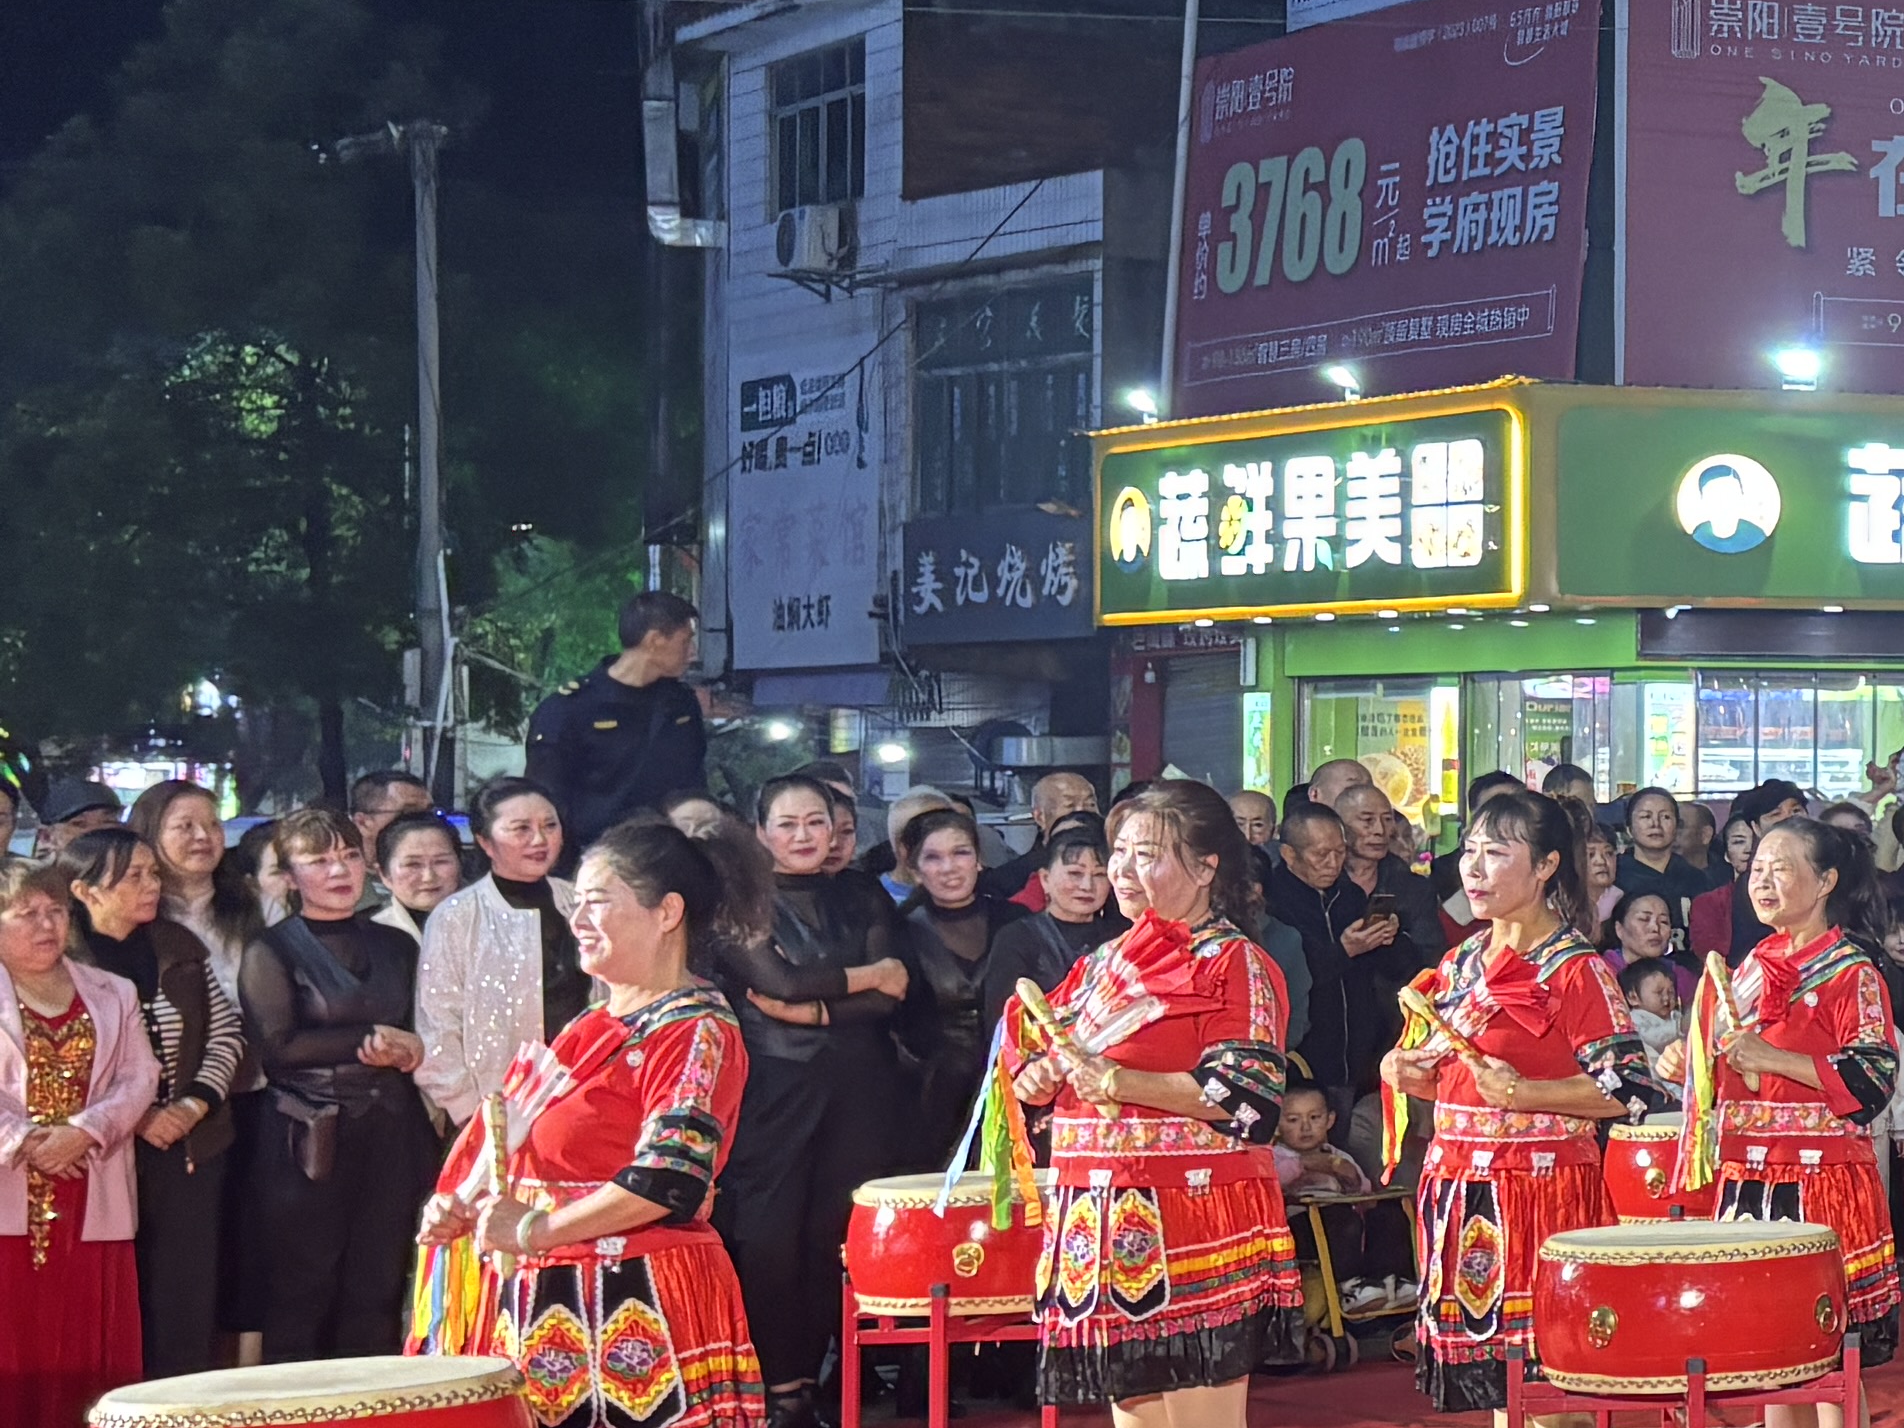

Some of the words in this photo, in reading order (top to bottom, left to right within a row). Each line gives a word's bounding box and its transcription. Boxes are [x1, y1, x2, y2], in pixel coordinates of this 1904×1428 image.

[1709, 44, 1754, 60] ONE
[1771, 47, 1833, 64] SINO
[1844, 52, 1903, 69] YARD
[1425, 105, 1566, 187] 抢住实景
[1215, 136, 1368, 295] 3768
[1420, 179, 1561, 261] 学府现房
